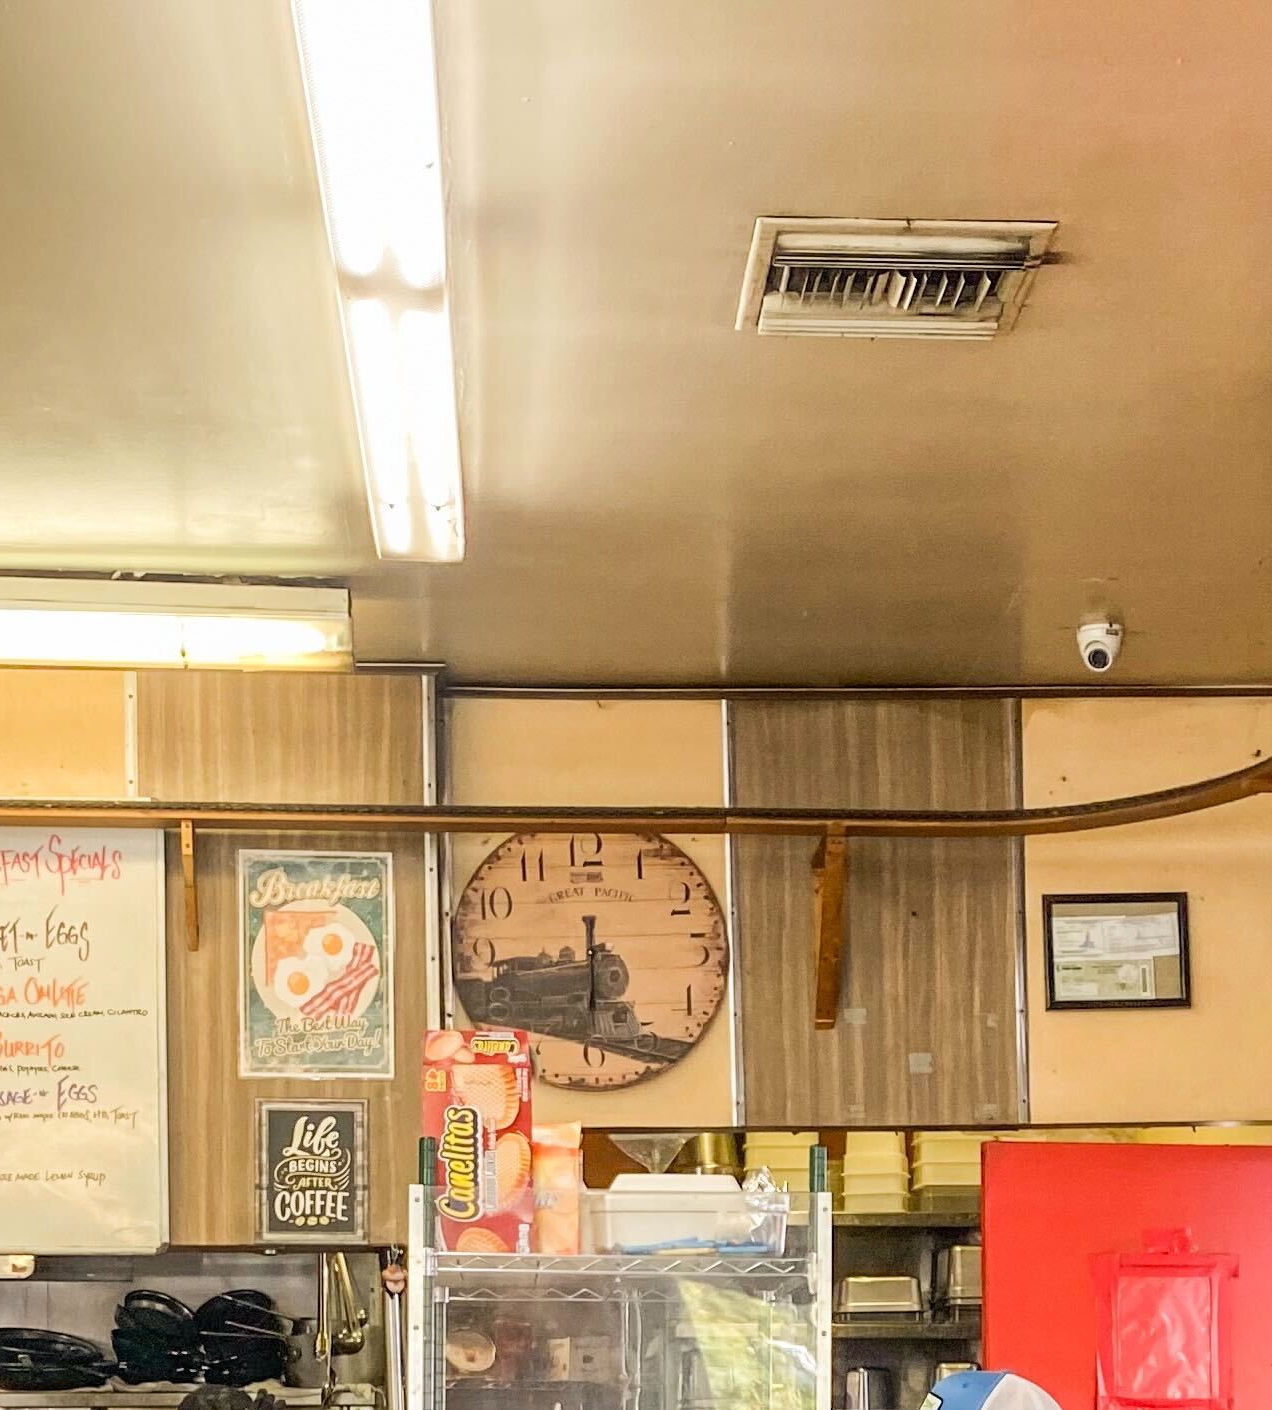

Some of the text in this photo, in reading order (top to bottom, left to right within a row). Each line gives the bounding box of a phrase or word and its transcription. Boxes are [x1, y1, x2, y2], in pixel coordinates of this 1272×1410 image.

[46, 833, 123, 896] SPECIALS
[520, 848, 545, 882] 11
[569, 832, 604, 868] 12
[249, 866, 381, 908] Breakfast
[480, 886, 514, 921] 10
[549, 886, 585, 905] GREAT
[45, 904, 91, 962] EGGS
[7, 955, 46, 972] TOAST
[276, 1016, 300, 1034] The
[333, 1015, 370, 1036] Way
[254, 1036, 274, 1058] To
[275, 1034, 313, 1057] Start
[56, 1075, 100, 1112] EGGS
[282, 1115, 341, 1157] Life
[288, 1158, 337, 1174] BEGINS
[438, 1106, 478, 1220] Canelitas
[293, 1176, 339, 1191] AFTER
[274, 1189, 350, 1222] COFFEE
